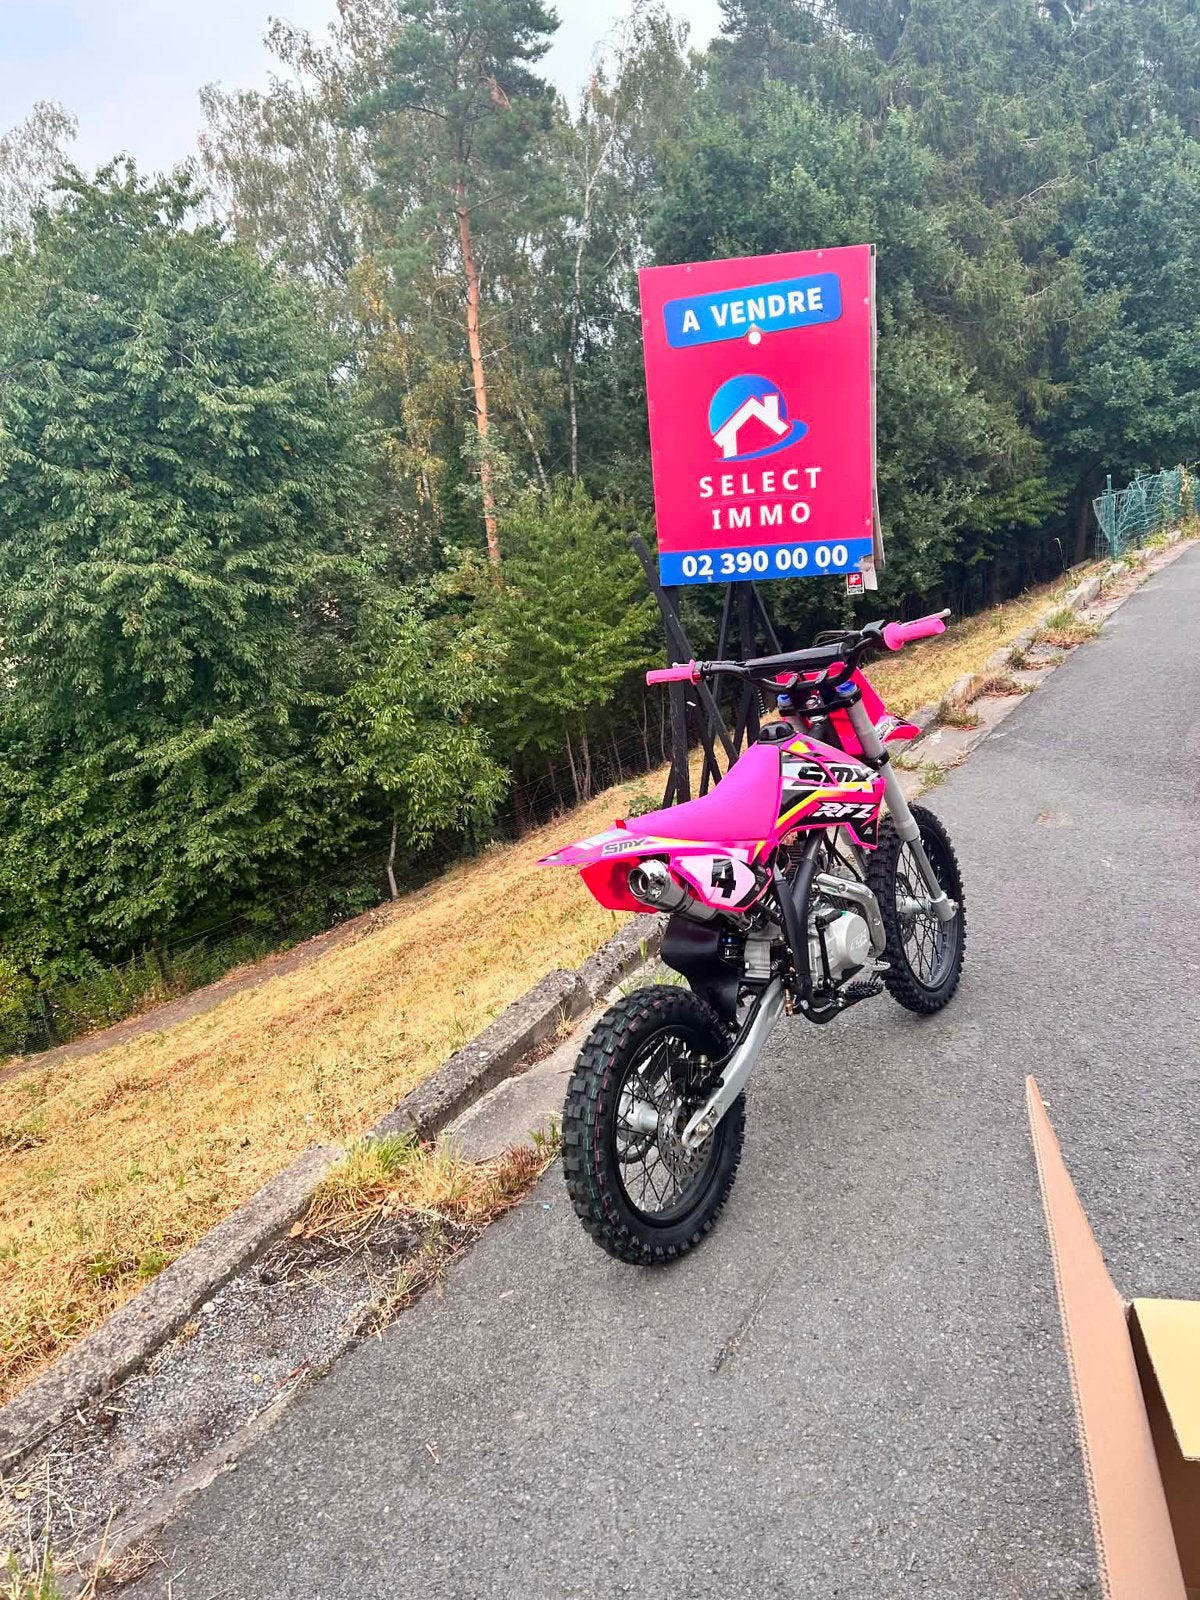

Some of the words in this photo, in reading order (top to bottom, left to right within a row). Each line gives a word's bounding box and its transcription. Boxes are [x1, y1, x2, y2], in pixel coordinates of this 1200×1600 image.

[682, 309, 701, 333] A
[710, 287, 823, 327] VENDRE
[699, 467, 821, 498] SELECT
[712, 502, 811, 530] IMMO
[682, 555, 714, 577] 02
[720, 550, 769, 575] 390
[775, 547, 809, 571] 00
[815, 544, 849, 568] 00
[811, 802, 877, 818] RFZ
[711, 858, 736, 898] 4
